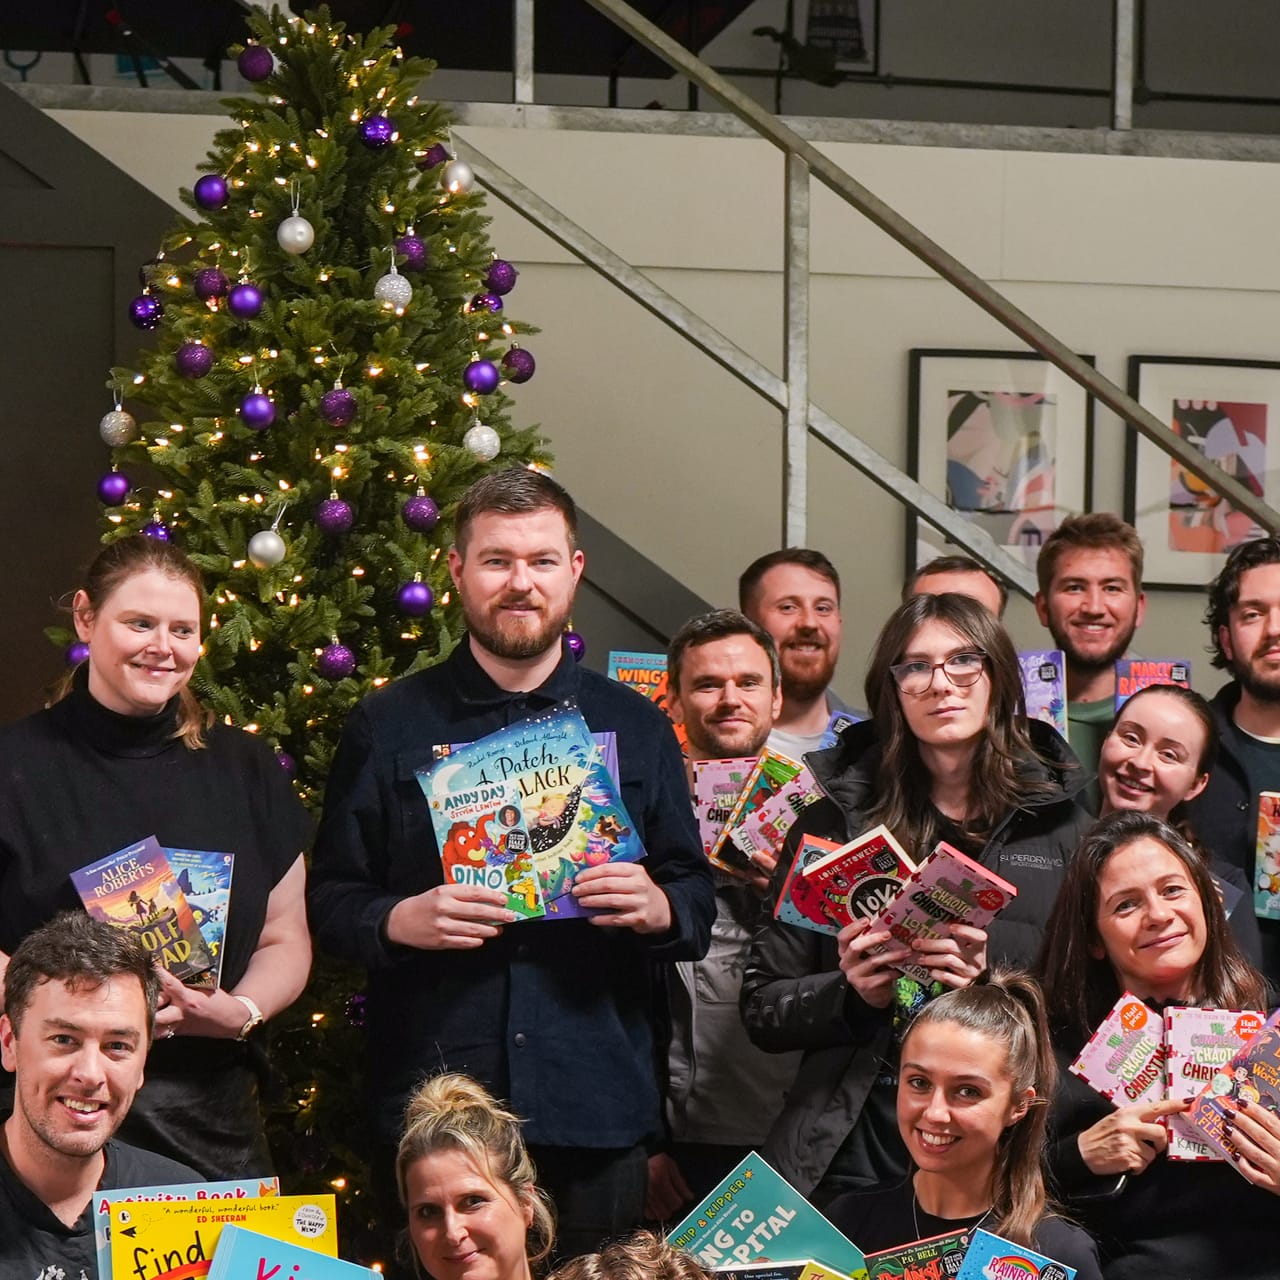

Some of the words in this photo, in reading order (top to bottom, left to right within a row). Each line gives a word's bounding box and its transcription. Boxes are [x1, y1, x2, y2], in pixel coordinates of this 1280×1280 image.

[618, 668, 669, 684] WINGS
[474, 769, 493, 787] A
[494, 743, 559, 781] Patch
[519, 765, 572, 799] LACK
[444, 789, 479, 811] ANDY
[481, 785, 506, 802] DAY
[101, 858, 141, 883] ALICE
[818, 866, 841, 880] LOUIE
[842, 845, 879, 867] STOWELL
[94, 863, 155, 898] ROBERTS
[454, 867, 503, 889] DINO
[141, 916, 179, 952] OLF
[1240, 1019, 1258, 1028] Half
[1240, 1026, 1258, 1034] price
[1121, 1036, 1158, 1079] CHAOTIC
[1177, 1138, 1208, 1155] KATIE
[218, 1204, 256, 1212] wonderful
[706, 1178, 745, 1219] KIPPER
[211, 1214, 246, 1222] SHEERAN
[731, 1209, 755, 1231] TO
[723, 1205, 797, 1266] SPITAL
